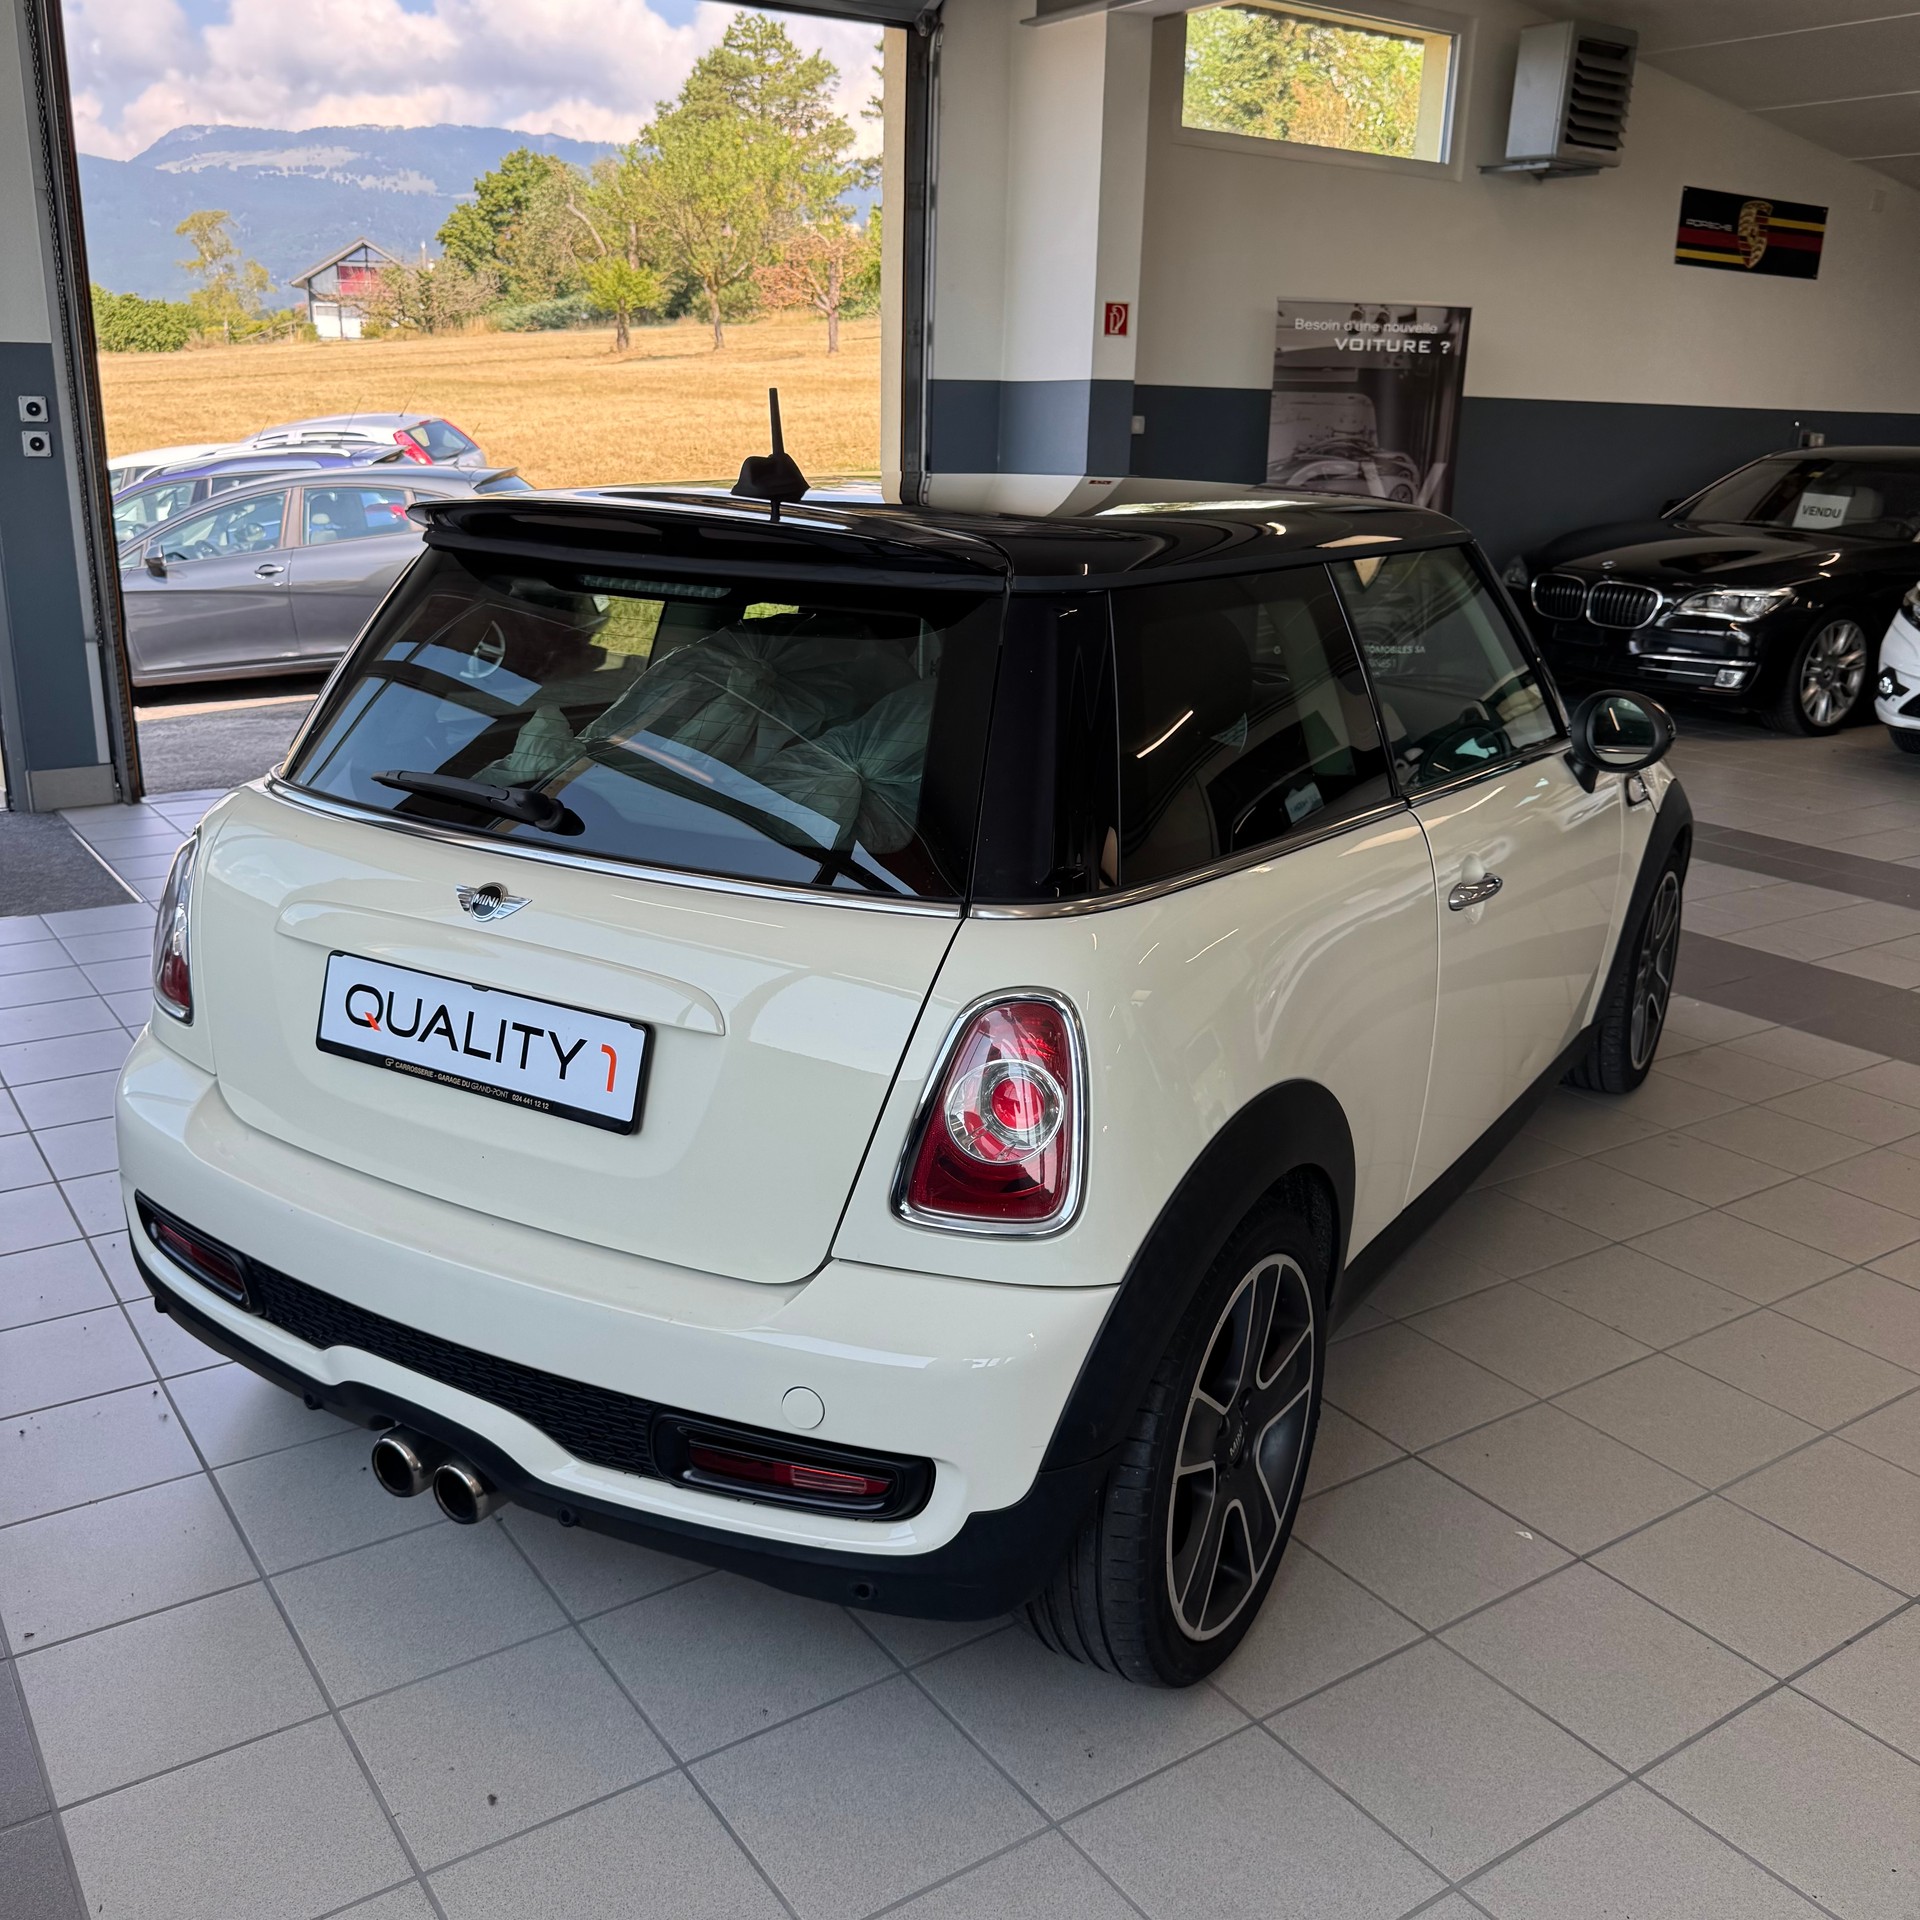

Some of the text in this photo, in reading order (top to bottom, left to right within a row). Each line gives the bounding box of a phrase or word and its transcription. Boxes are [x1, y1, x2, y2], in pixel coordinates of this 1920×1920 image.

[1294, 318, 1438, 334] Besoin d'une nouvelle
[1334, 337, 1451, 354] VOITURE ?
[1802, 505, 1842, 518] VENDU
[473, 893, 499, 908] MINI
[345, 984, 588, 1080] QUALITY
[395, 1061, 434, 1078] CARROSSERIE
[437, 1073, 461, 1086] GARAGE
[461, 1079, 471, 1088] DU
[471, 1082, 509, 1099] GRAND-PONT
[511, 1094, 522, 1102] 024
[522, 1097, 533, 1105] 441
[542, 1102, 549, 1110] 12
